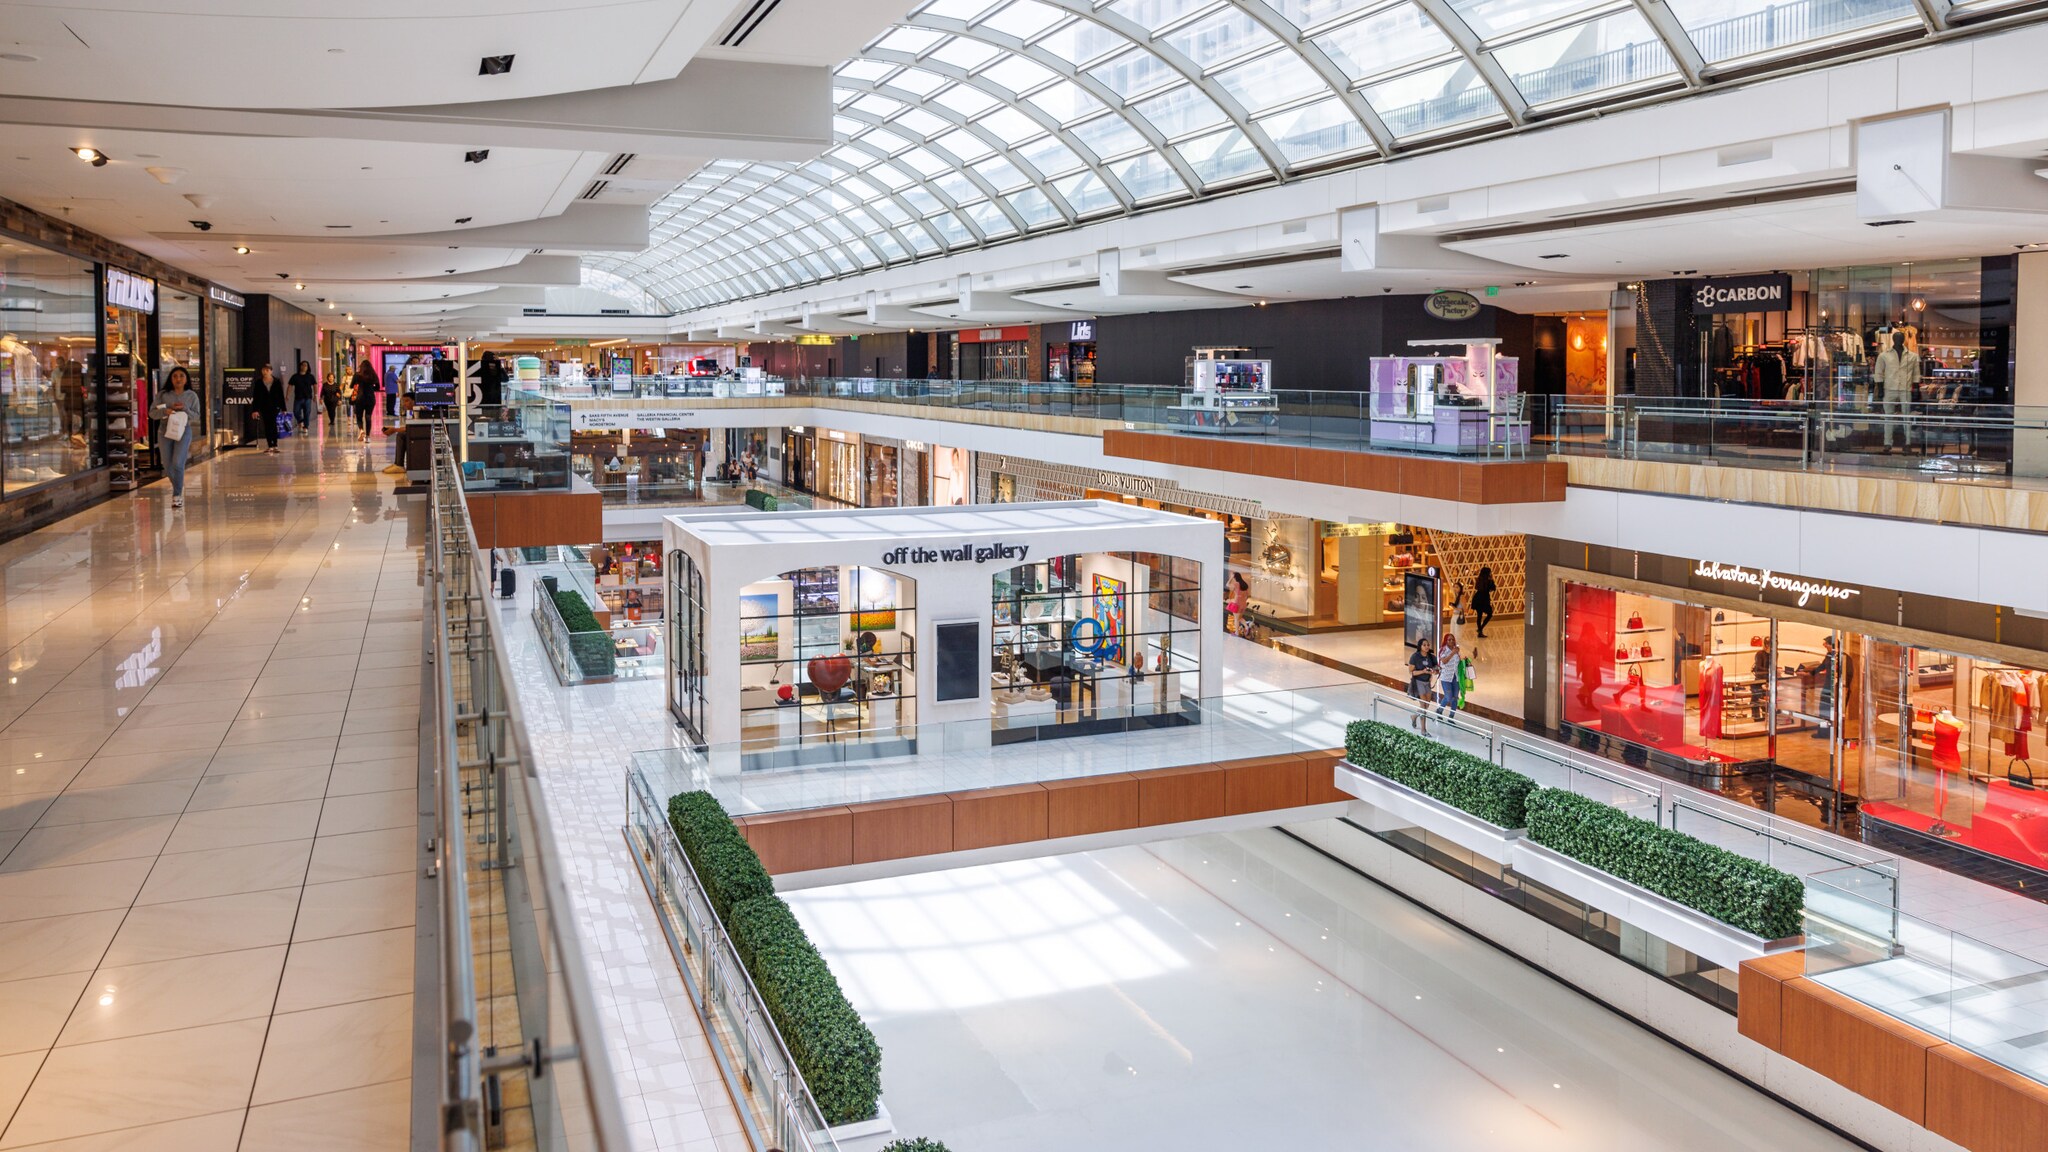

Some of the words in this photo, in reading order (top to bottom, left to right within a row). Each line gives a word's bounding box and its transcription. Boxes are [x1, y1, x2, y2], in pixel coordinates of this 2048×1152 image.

[107, 269, 154, 315] TILLYS
[1716, 285, 1782, 302] CARBON
[1433, 296, 1469, 309] Cheesecake
[1441, 304, 1468, 316] Factory
[1071, 322, 1092, 340] Lids
[1098, 472, 1120, 488] LOUIS
[1120, 476, 1155, 494] VUITTON
[882, 546, 909, 564] off
[910, 546, 937, 563] the
[940, 544, 973, 562] wall
[975, 543, 1029, 563] gallery
[1695, 560, 1761, 586] Salvatore
[1760, 568, 1860, 607] Ferragamo
